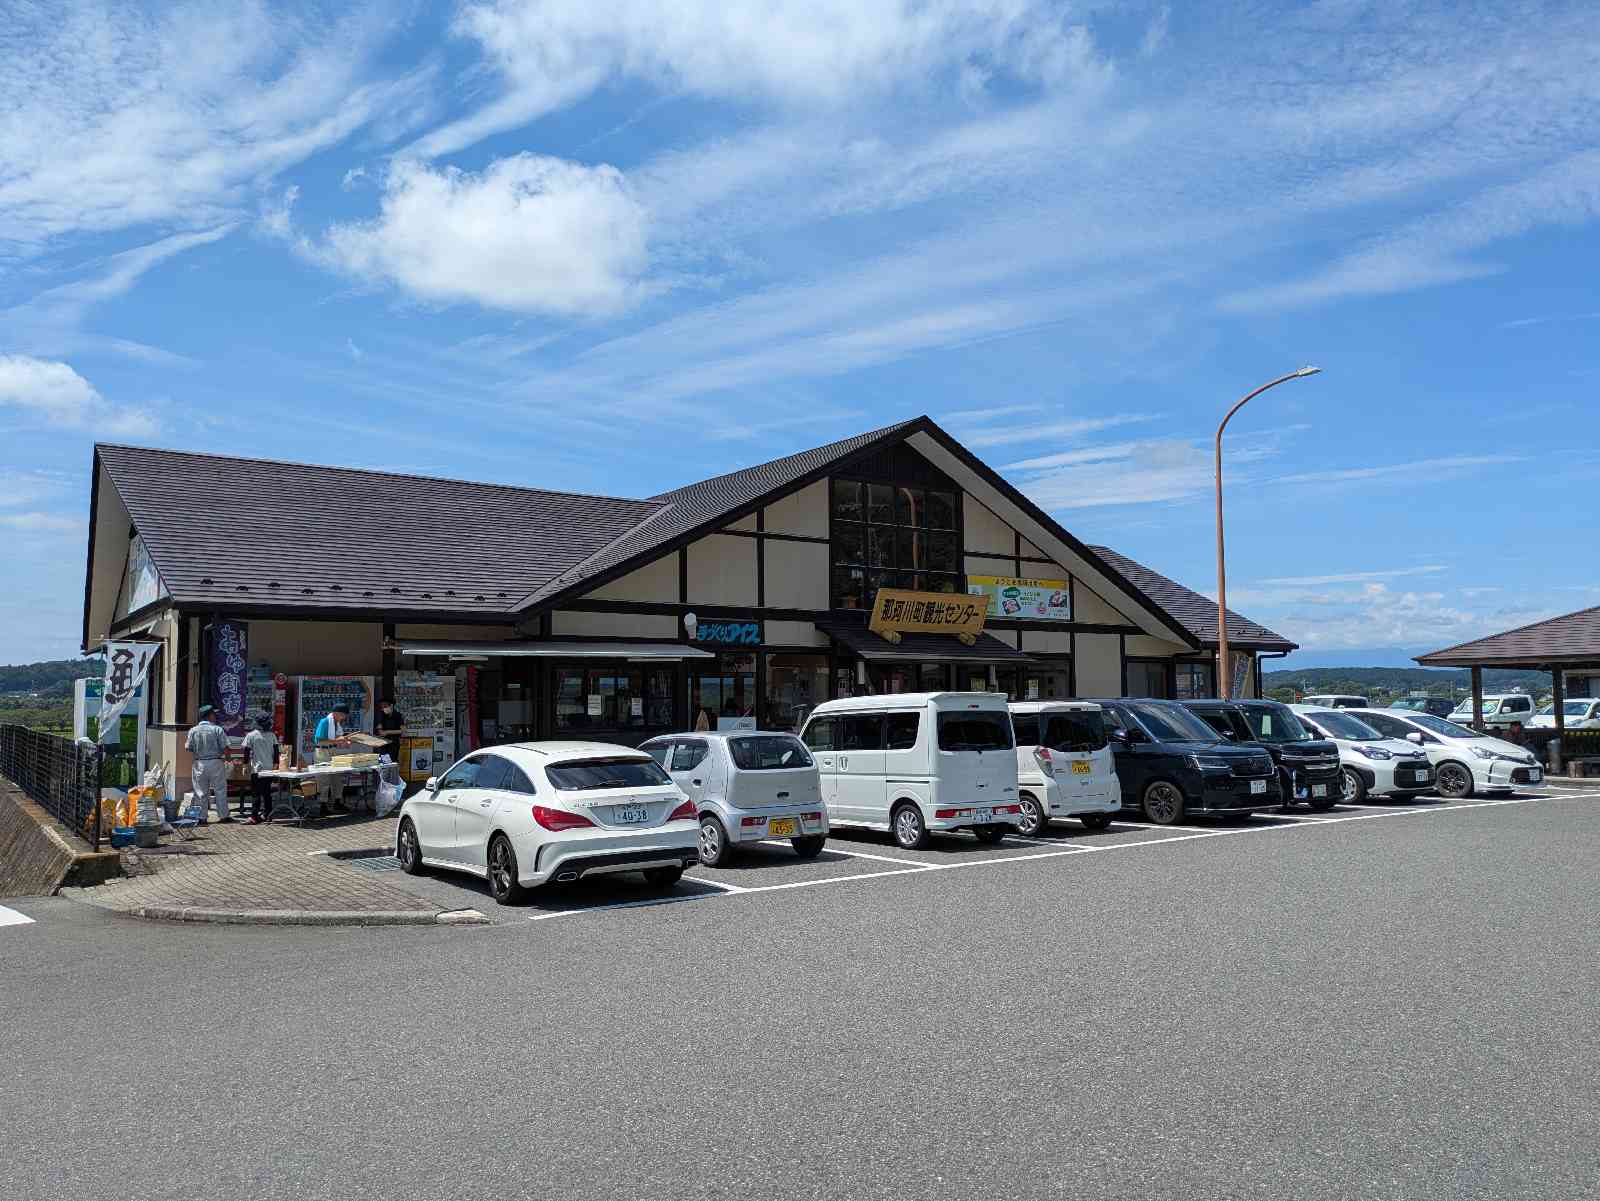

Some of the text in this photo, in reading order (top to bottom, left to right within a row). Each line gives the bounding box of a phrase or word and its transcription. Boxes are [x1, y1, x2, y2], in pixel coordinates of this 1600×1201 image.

[880, 598, 980, 625] 那珂川町観光センター
